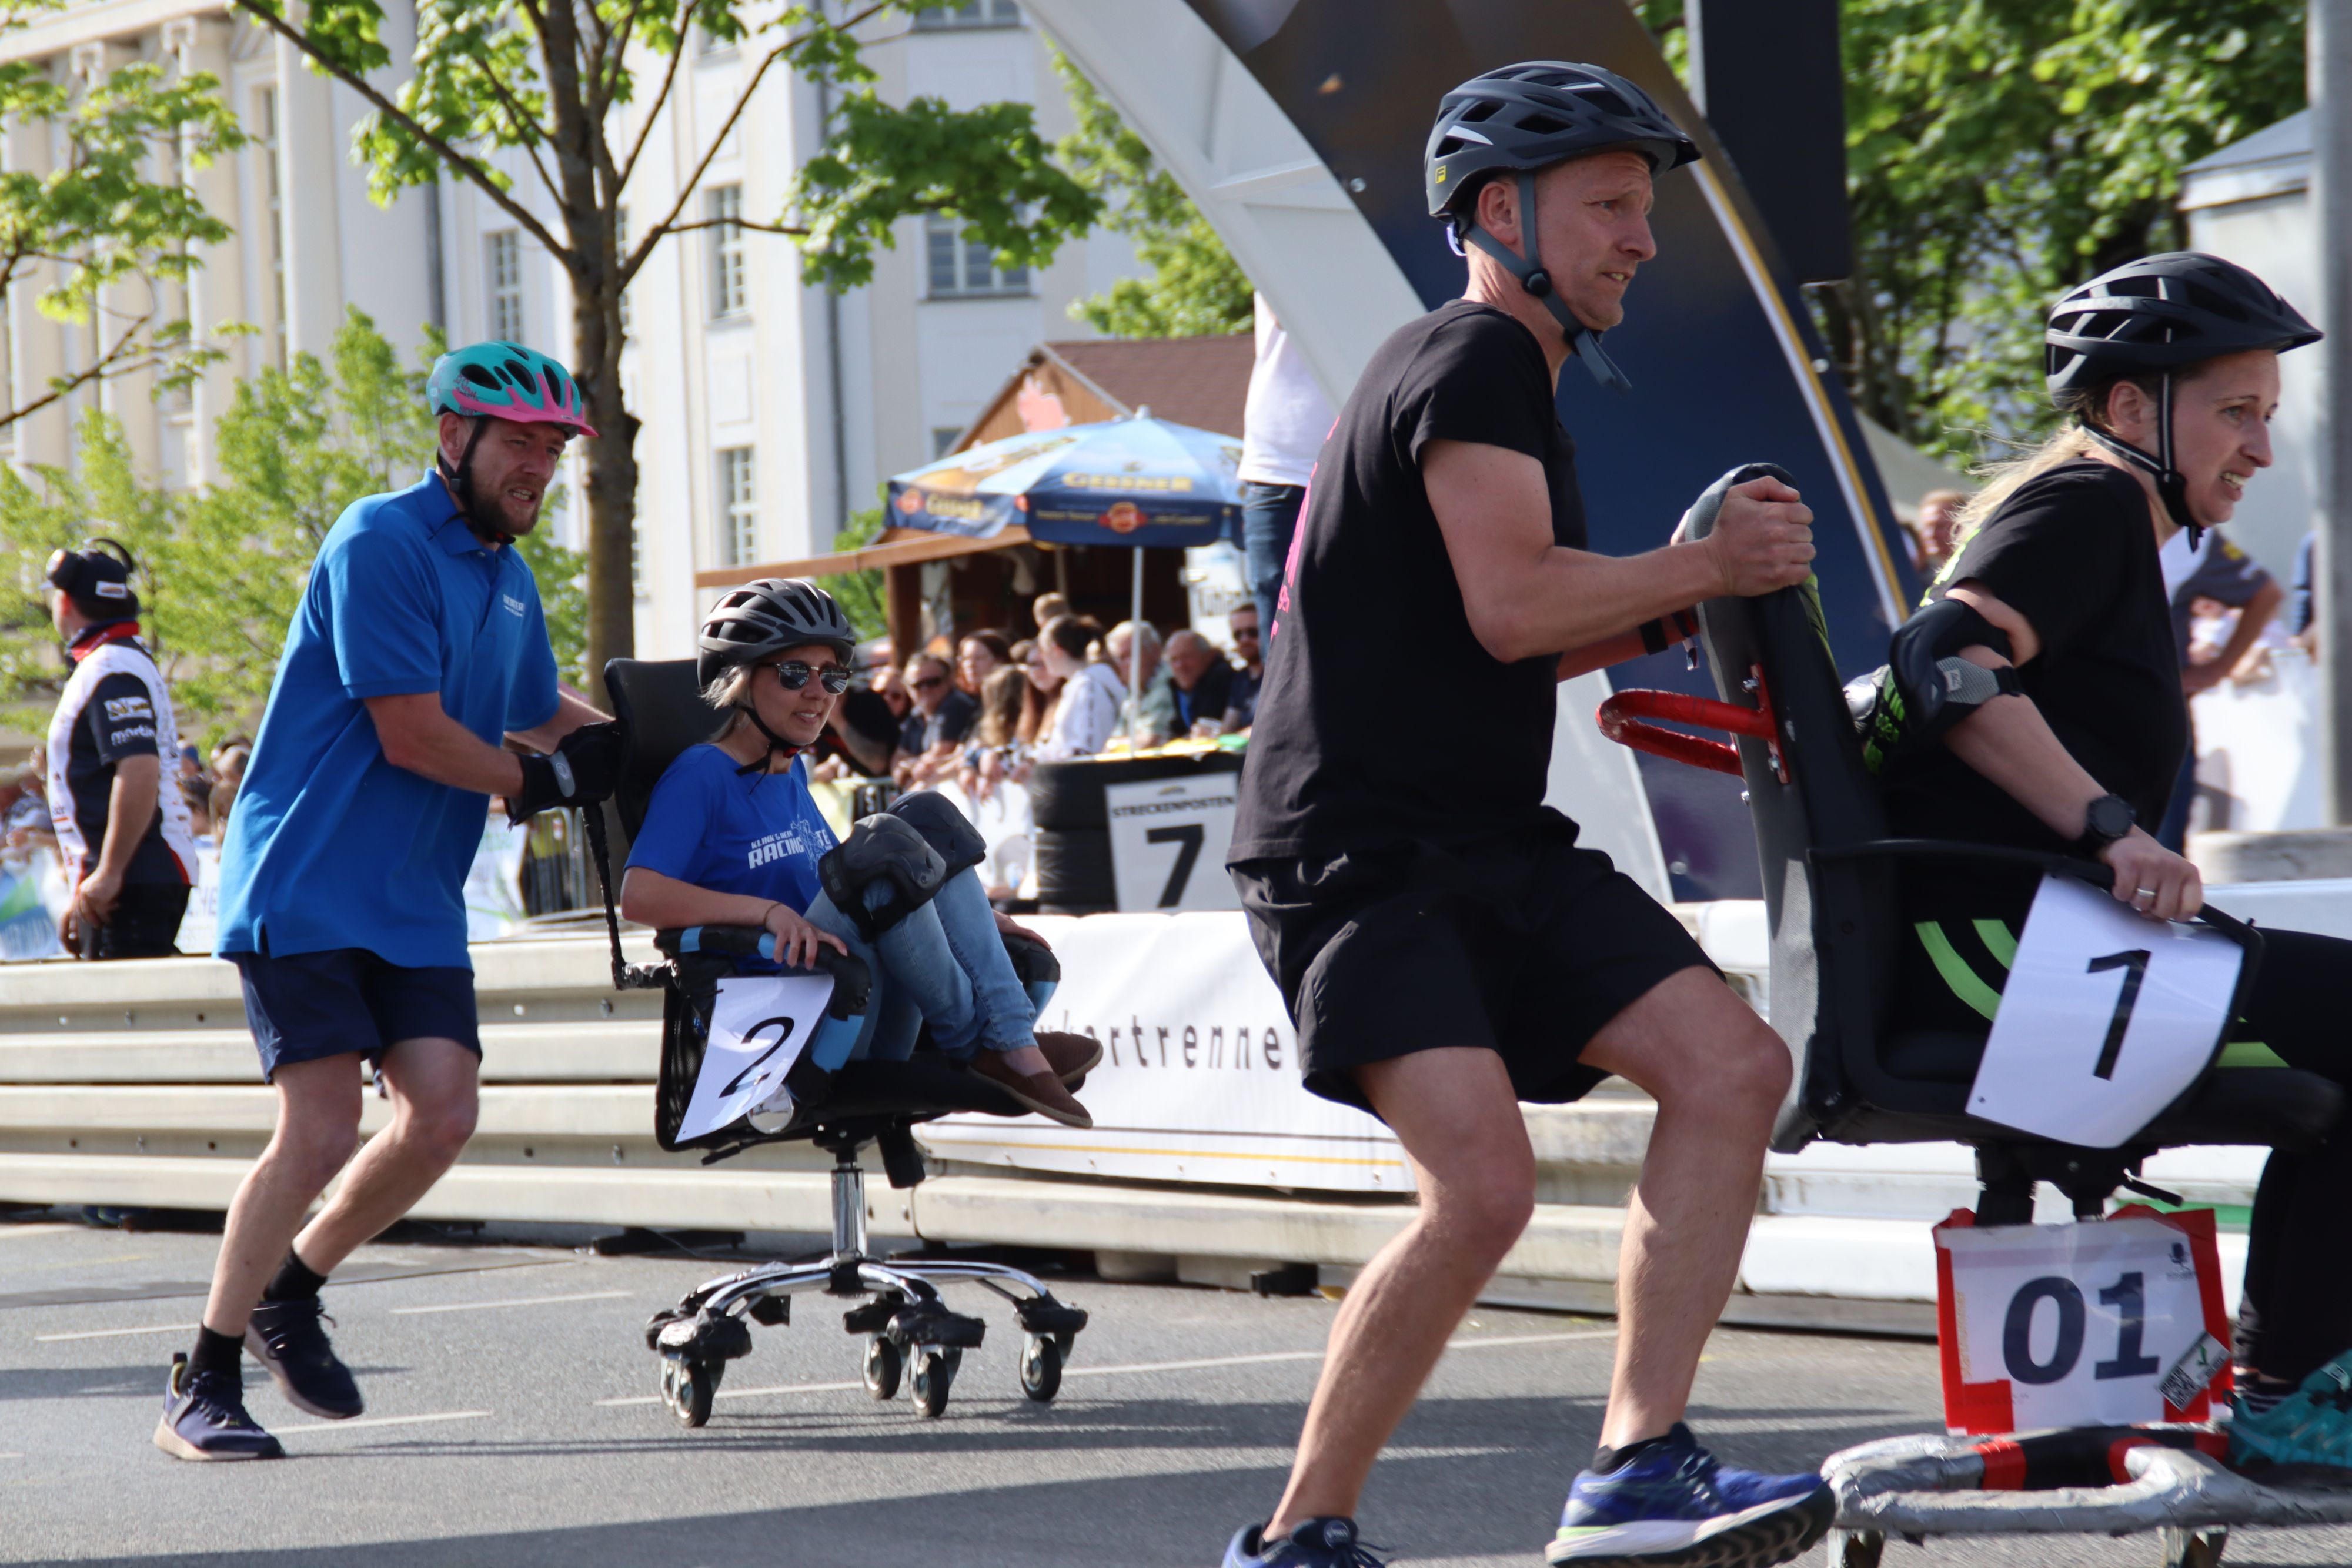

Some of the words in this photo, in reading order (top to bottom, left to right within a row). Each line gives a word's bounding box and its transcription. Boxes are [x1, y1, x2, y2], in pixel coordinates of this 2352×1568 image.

[751, 834, 775, 850] KLINK
[1112, 795, 1234, 818] STRECKENPOSTEN
[748, 837, 805, 870] RACING
[1146, 823, 1205, 908] 7
[2086, 948, 2153, 1082] 1
[718, 1016, 795, 1099] 2
[2002, 1271, 2160, 1386] 01
